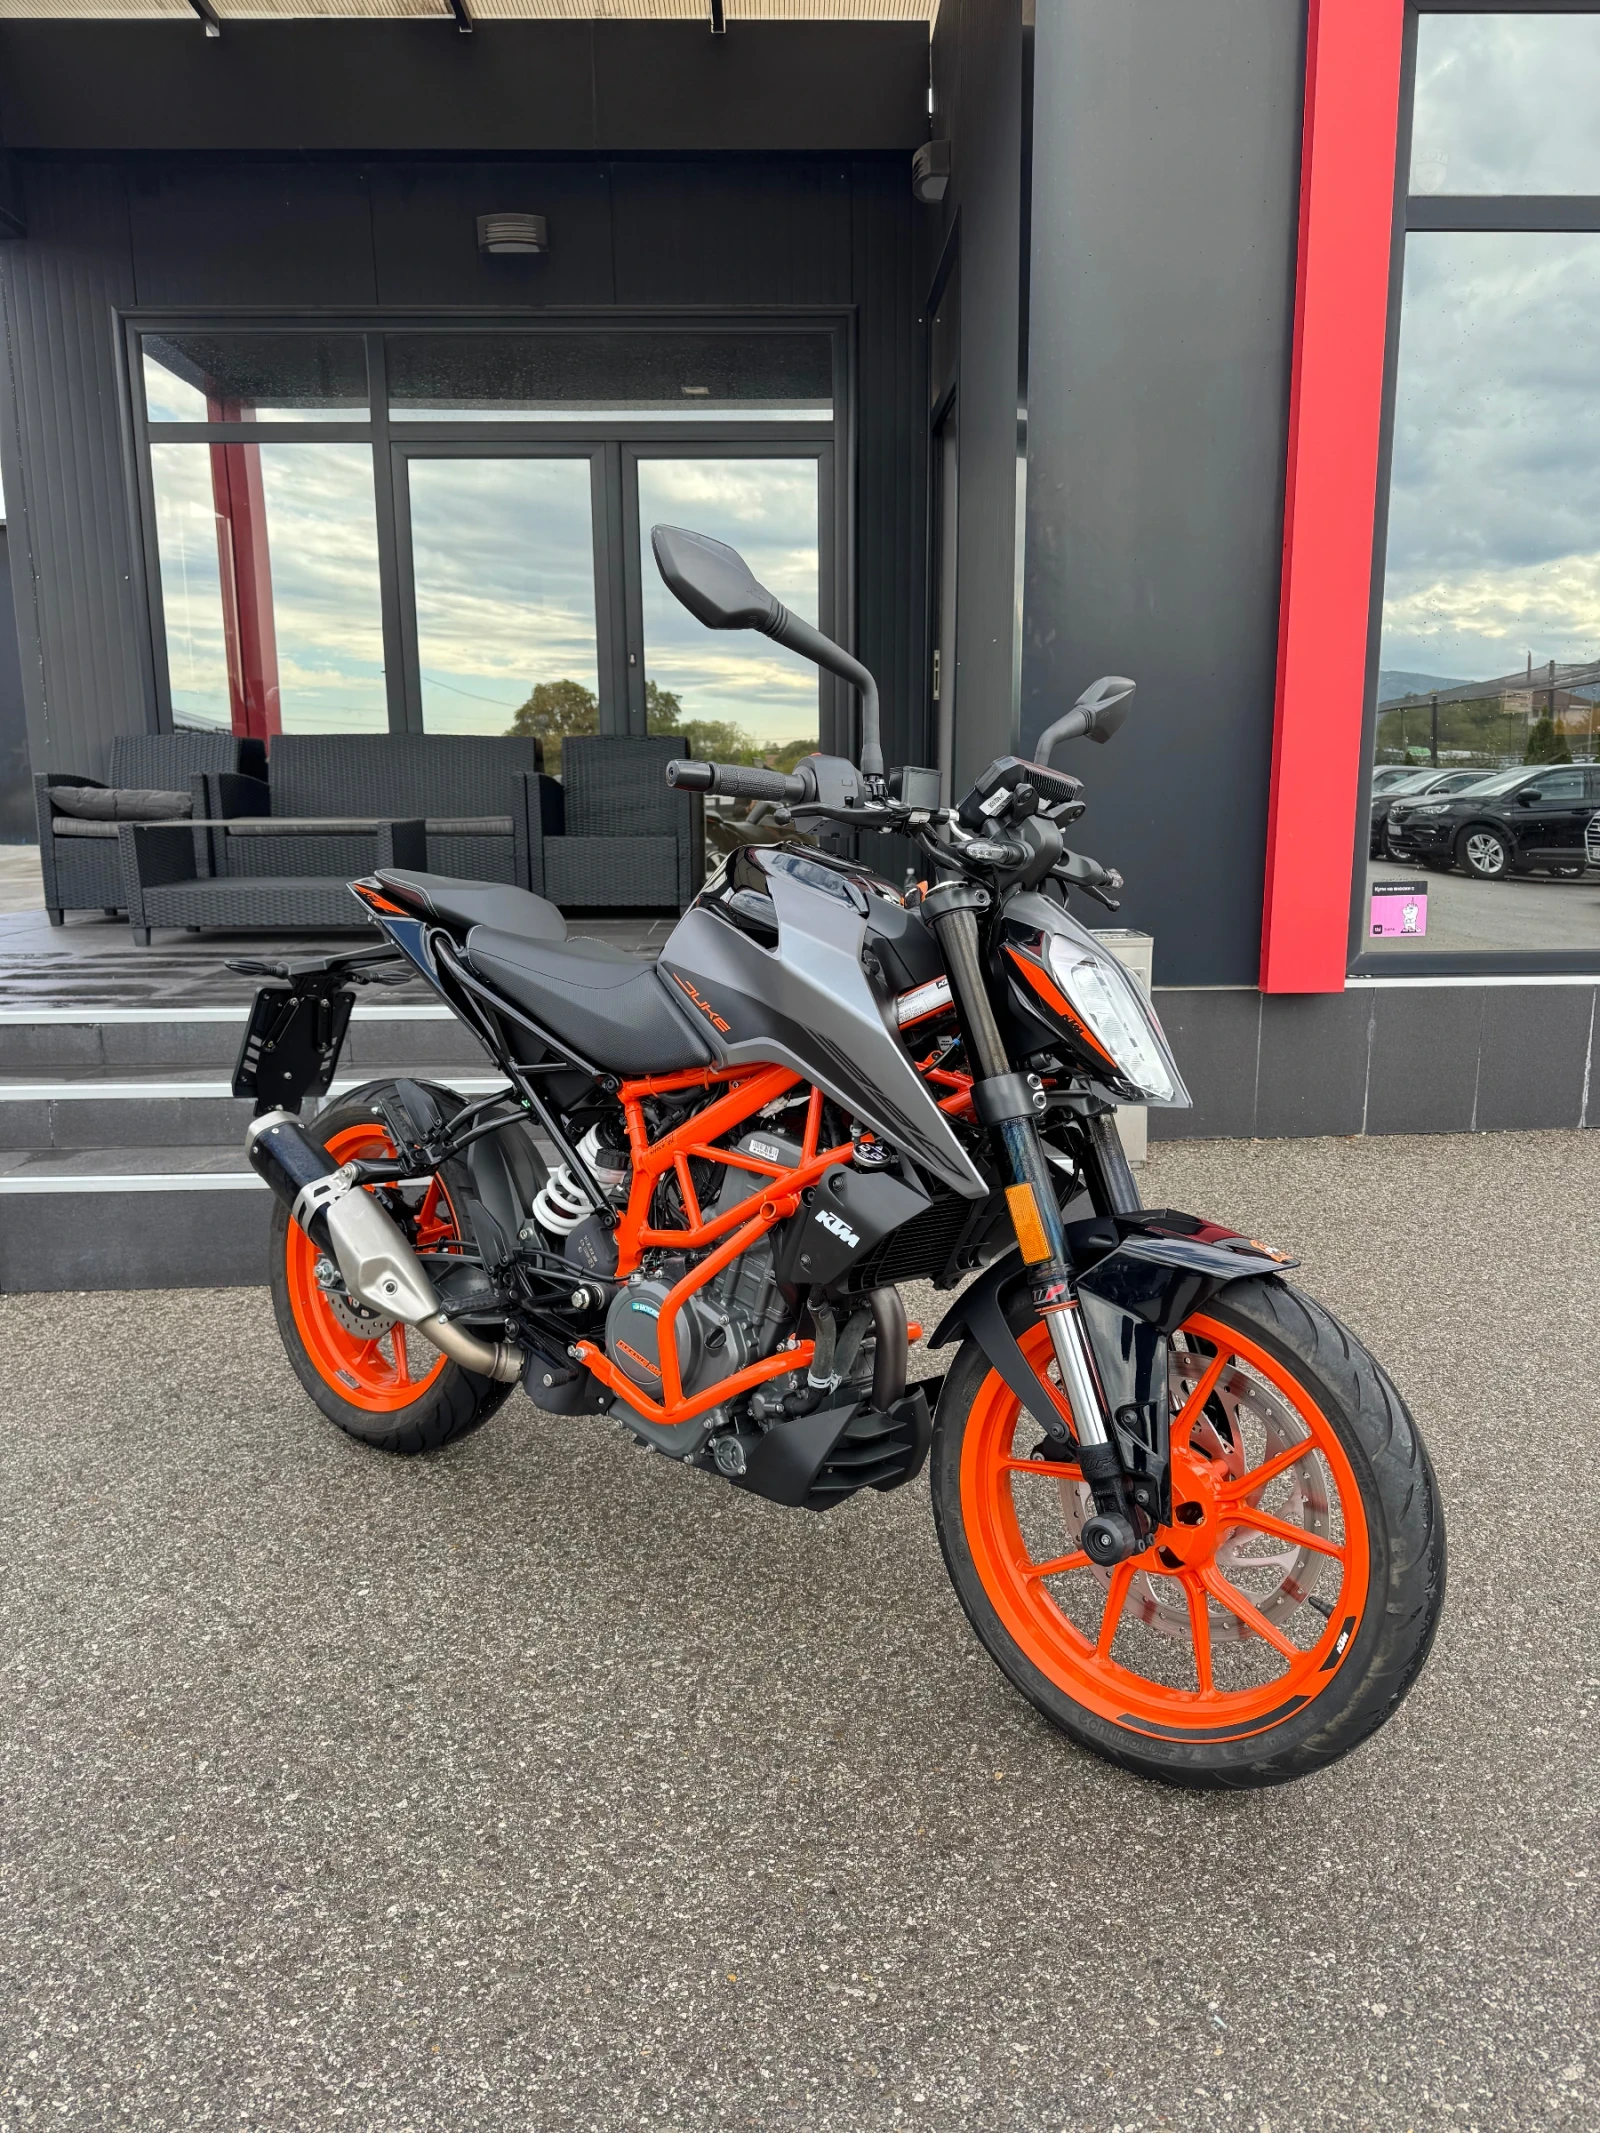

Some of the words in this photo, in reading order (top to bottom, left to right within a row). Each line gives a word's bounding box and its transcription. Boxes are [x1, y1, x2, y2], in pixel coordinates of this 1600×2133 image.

[673, 972, 731, 1033] DUKE
[1061, 1014, 1084, 1036] KTM
[805, 1027, 972, 1182] 390
[815, 1209, 861, 1249] KTM
[1336, 1631, 1350, 1655] KTM
